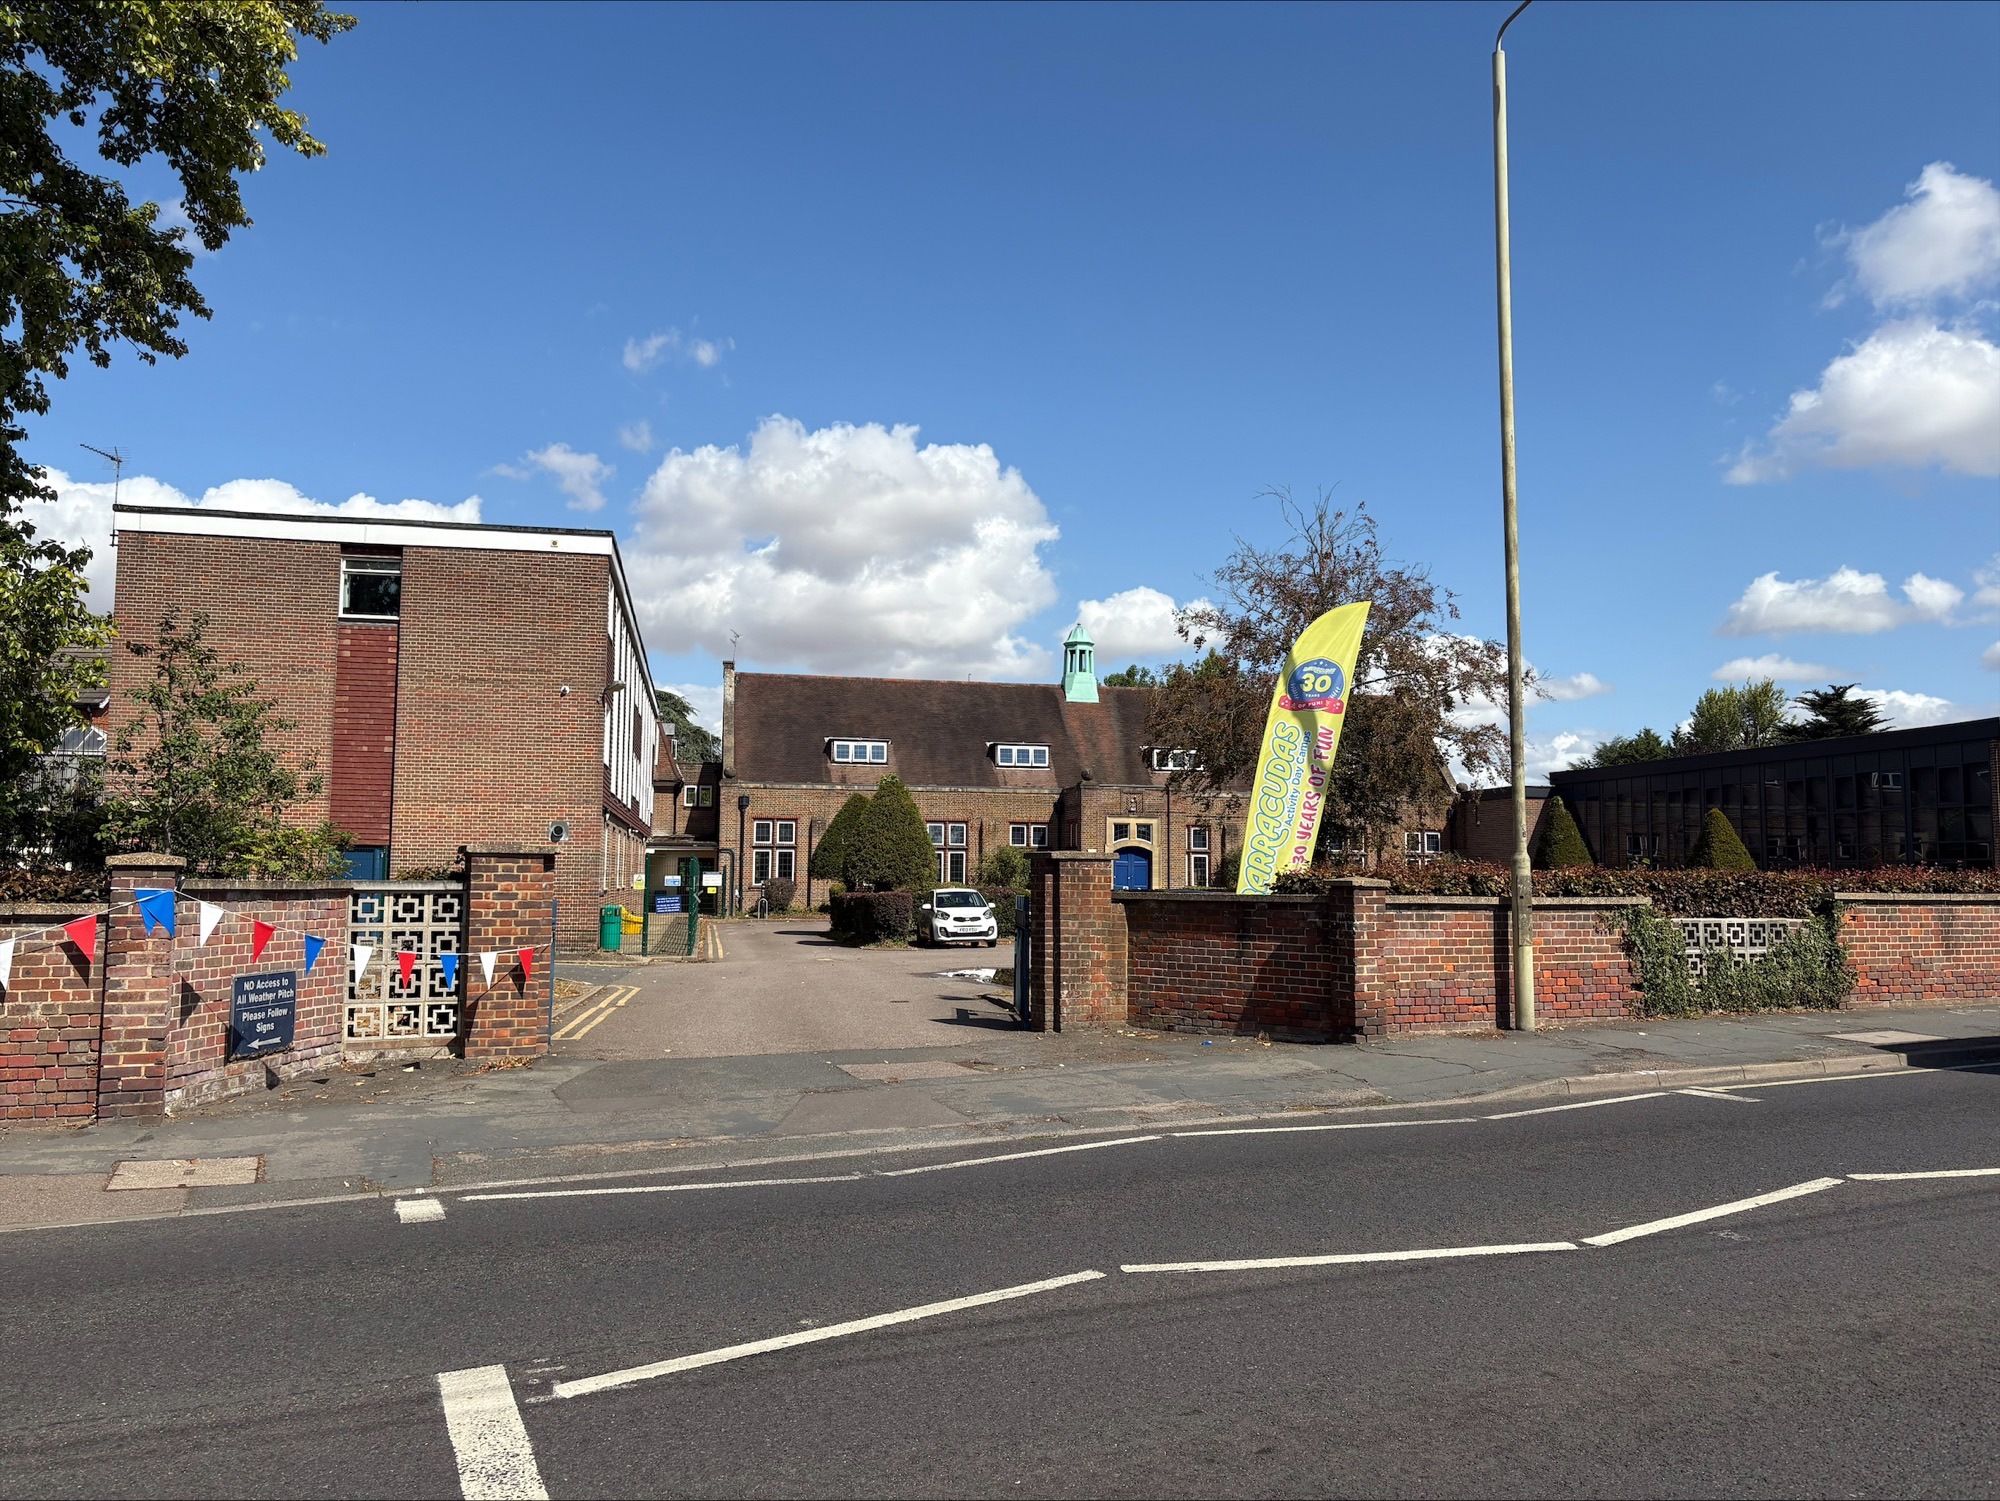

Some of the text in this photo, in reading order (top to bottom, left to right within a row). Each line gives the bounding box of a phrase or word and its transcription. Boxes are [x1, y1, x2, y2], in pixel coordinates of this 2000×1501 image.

[1300, 673, 1332, 692] 30
[1313, 726, 1333, 760] FUN
[1285, 731, 1311, 826] Activity Day Camps
[1308, 764, 1326, 787] OF
[1296, 791, 1321, 840] YEARS
[1292, 846, 1307, 863] 30
[244, 977, 289, 991] NO Access to
[237, 988, 294, 1005] All Weather Pitch
[242, 1007, 288, 1021] Please Follow
[256, 1022, 275, 1033] Signs
